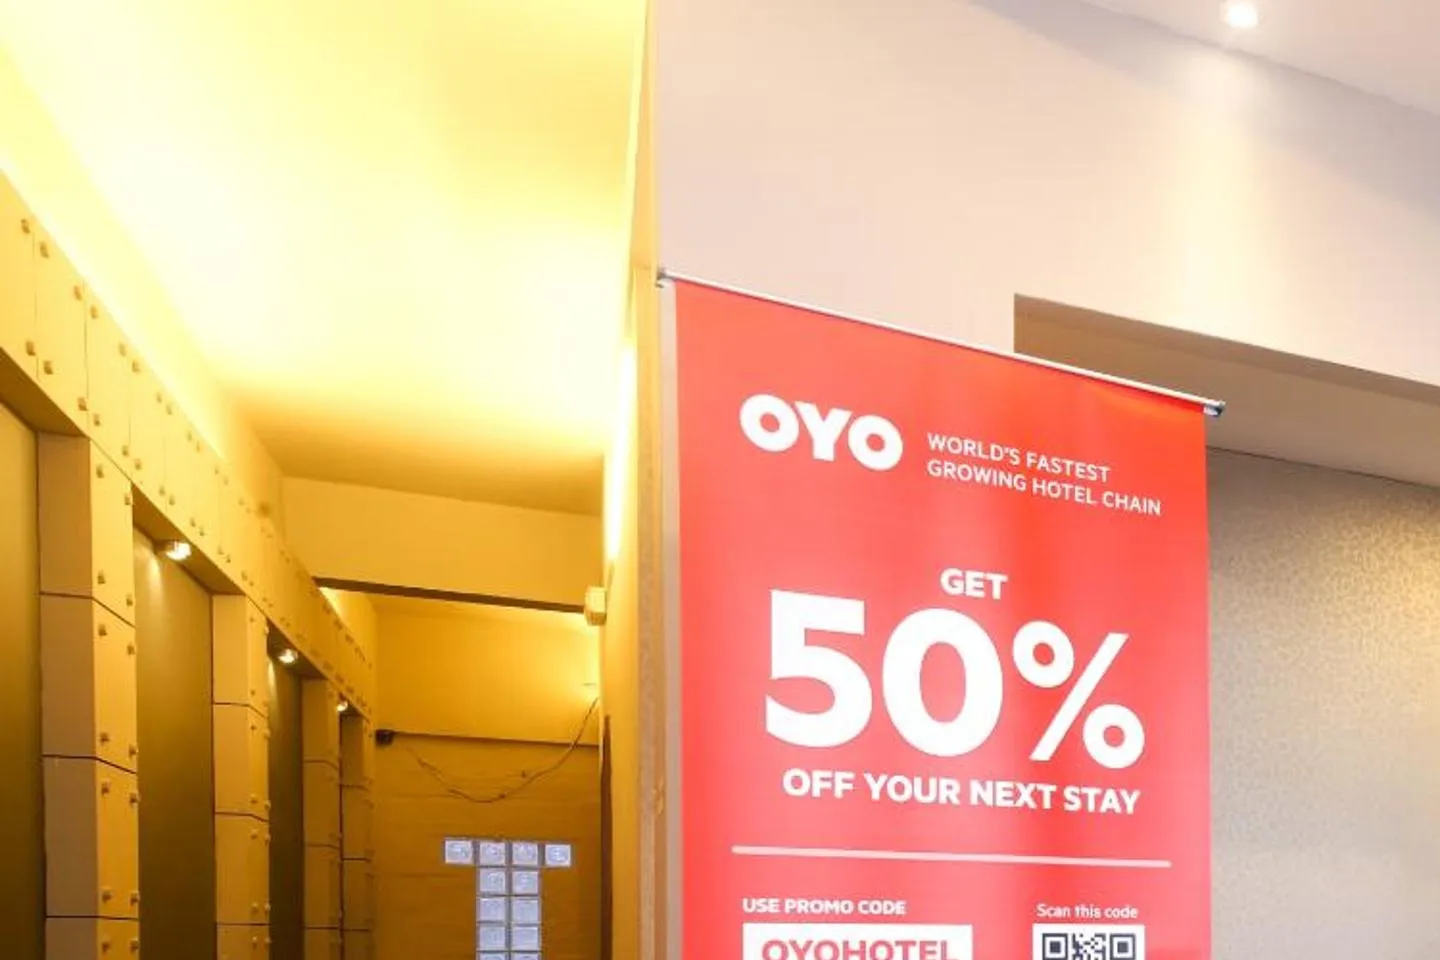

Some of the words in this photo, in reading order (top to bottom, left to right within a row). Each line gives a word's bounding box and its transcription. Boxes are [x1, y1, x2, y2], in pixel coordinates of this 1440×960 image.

[739, 394, 903, 471] OYO
[927, 432, 1020, 466] WORLD'S
[1026, 451, 1111, 483] FASTEST
[927, 459, 1027, 492] GROWING
[1032, 477, 1097, 505] HOTEL
[1102, 491, 1161, 516] CHAIN
[940, 567, 1007, 600] GET
[765, 589, 1145, 769] 50%
[783, 768, 855, 799] OFF
[864, 773, 961, 806] YOUR
[970, 780, 1056, 809] NEXT
[1063, 788, 1141, 815] STAY
[742, 898, 780, 913] USE
[785, 899, 854, 914] PROMO
[858, 900, 907, 915] CODE
[1036, 903, 1071, 917] Scan
[1074, 904, 1101, 918] this
[1104, 905, 1139, 919] code
